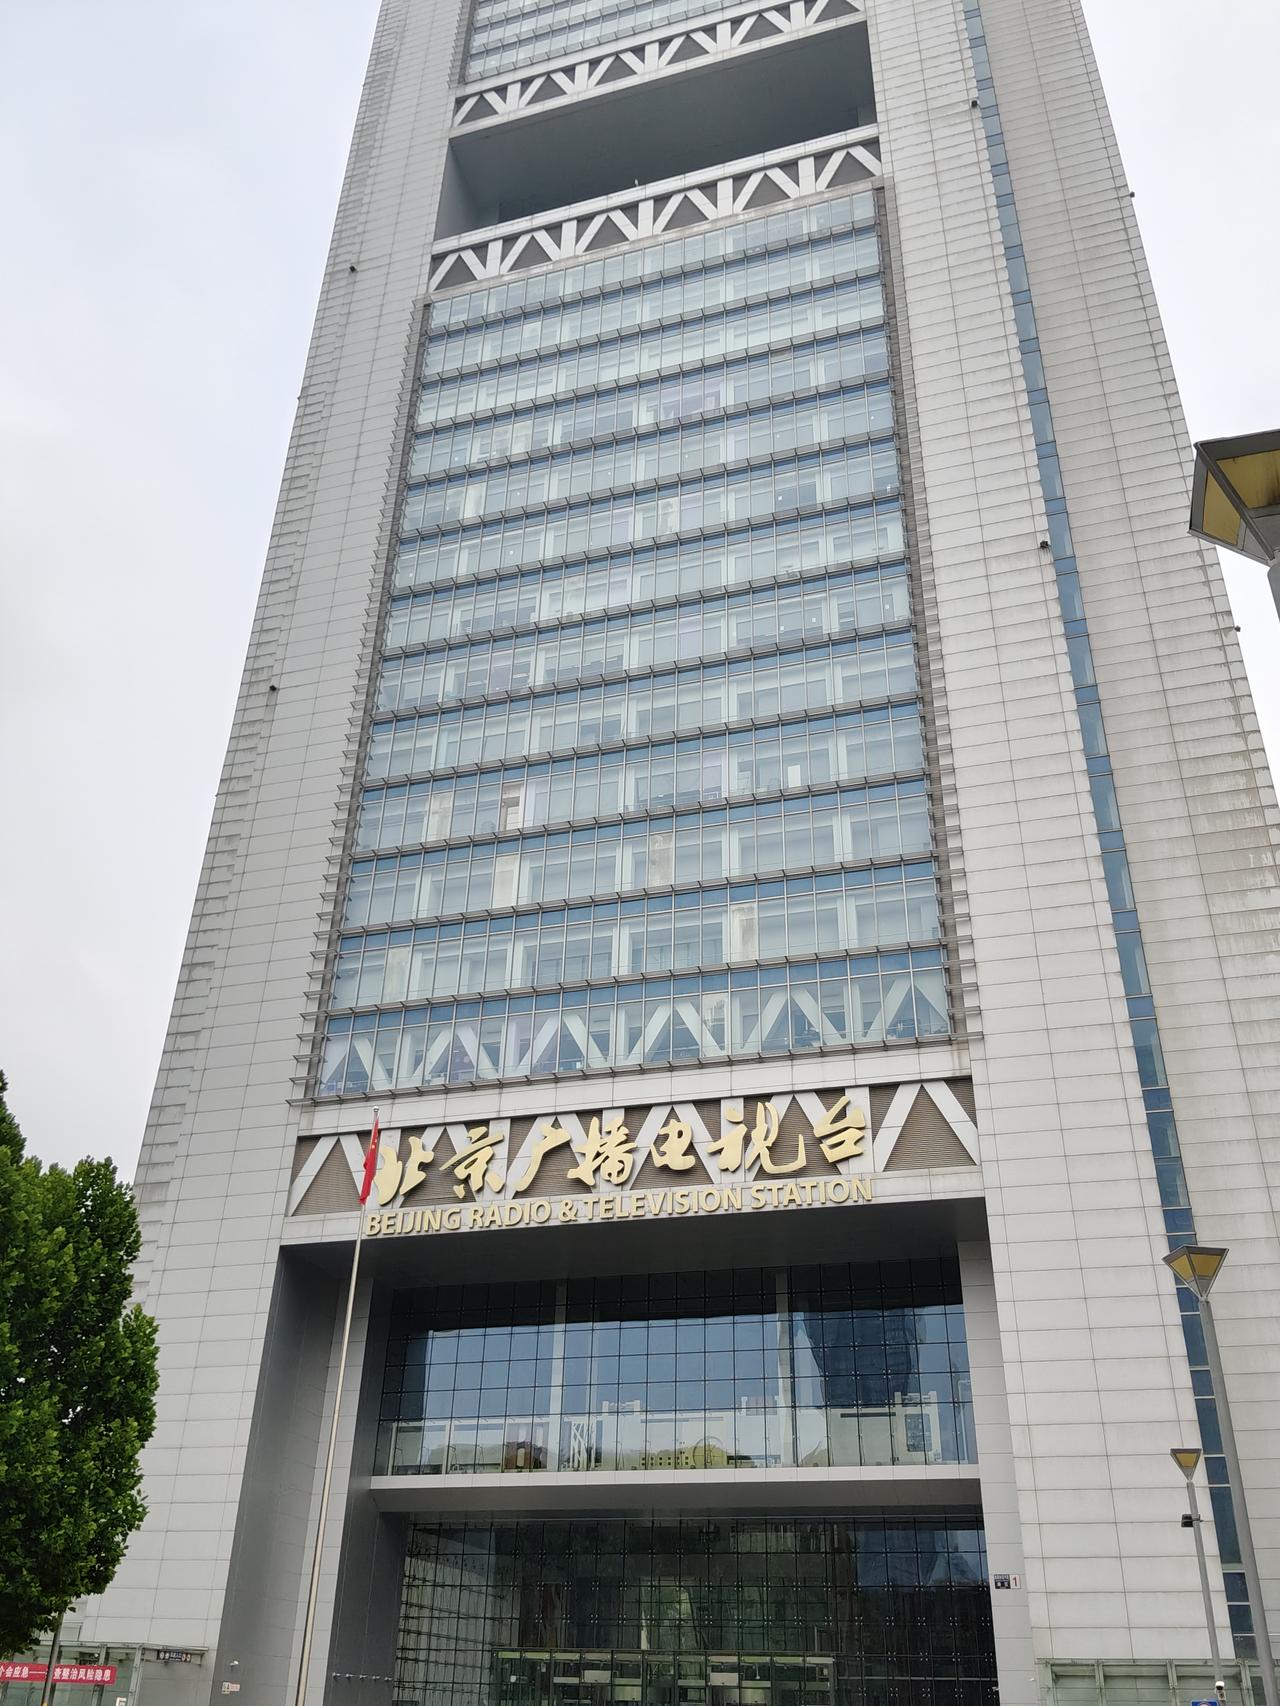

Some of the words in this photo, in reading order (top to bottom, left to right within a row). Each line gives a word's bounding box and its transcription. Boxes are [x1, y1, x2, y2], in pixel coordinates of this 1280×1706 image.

[372, 1095, 866, 1206] 北京广播电视台
[365, 1207, 462, 1237] BEIJING
[468, 1200, 552, 1229] RADIO
[583, 1184, 743, 1220] TELEVISION
[750, 1177, 873, 1210] STATION
